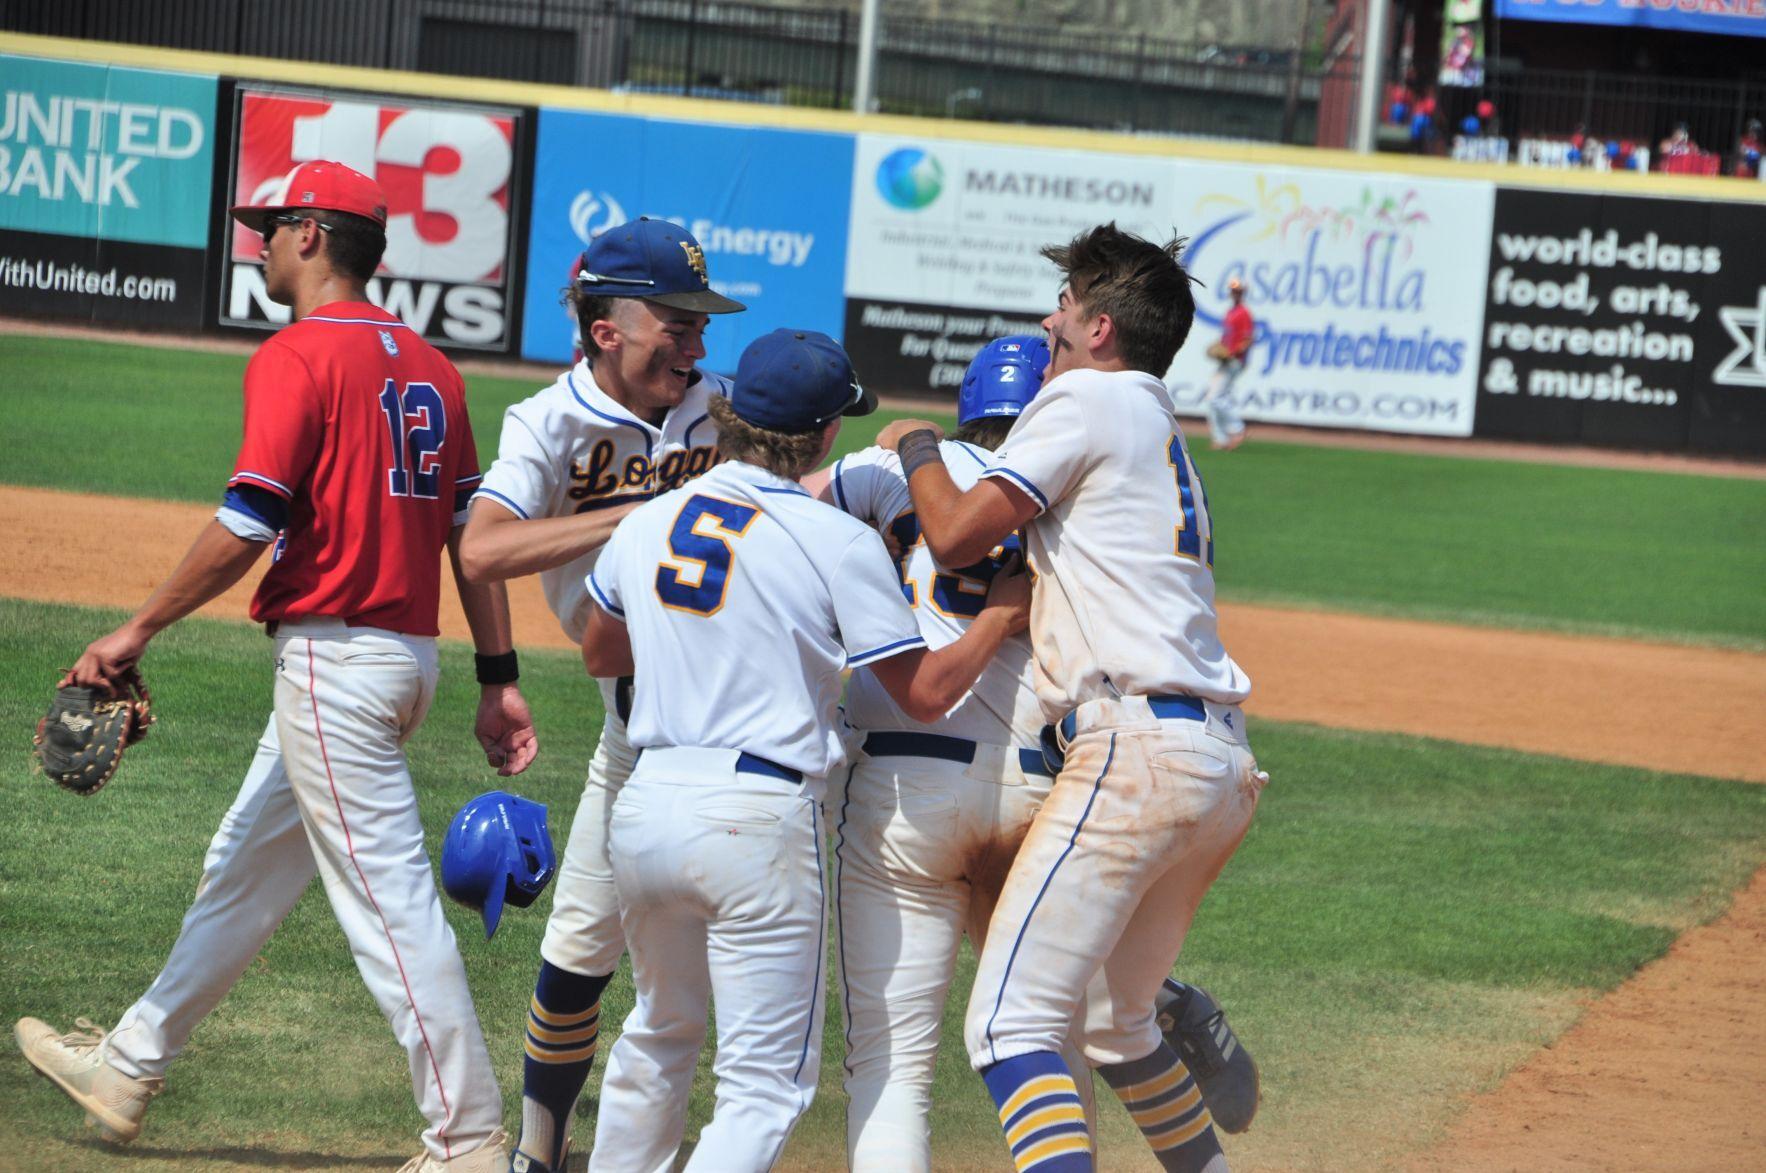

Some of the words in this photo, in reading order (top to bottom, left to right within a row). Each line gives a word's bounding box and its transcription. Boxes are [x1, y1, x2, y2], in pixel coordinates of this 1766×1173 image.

[291, 100, 512, 282] 13
[965, 168, 1155, 206] MATHESON
[692, 217, 815, 267] Energy
[1498, 227, 1722, 274] world-class
[0, 257, 176, 302] ithUnited.com
[230, 263, 504, 344] NWS
[1493, 266, 1599, 316] food,
[1610, 283, 1700, 322] arts,
[1243, 318, 1467, 377] Pyrotechnics
[1488, 321, 1694, 362] recreation
[1000, 366, 1015, 382] 2
[1484, 357, 1519, 394] &
[1528, 363, 1678, 406] music...
[1170, 382, 1459, 420] CAPYRO.COM
[379, 378, 447, 499] 12
[568, 439, 720, 499] Loga
[1166, 432, 1214, 570] 1
[655, 493, 763, 618] 5
